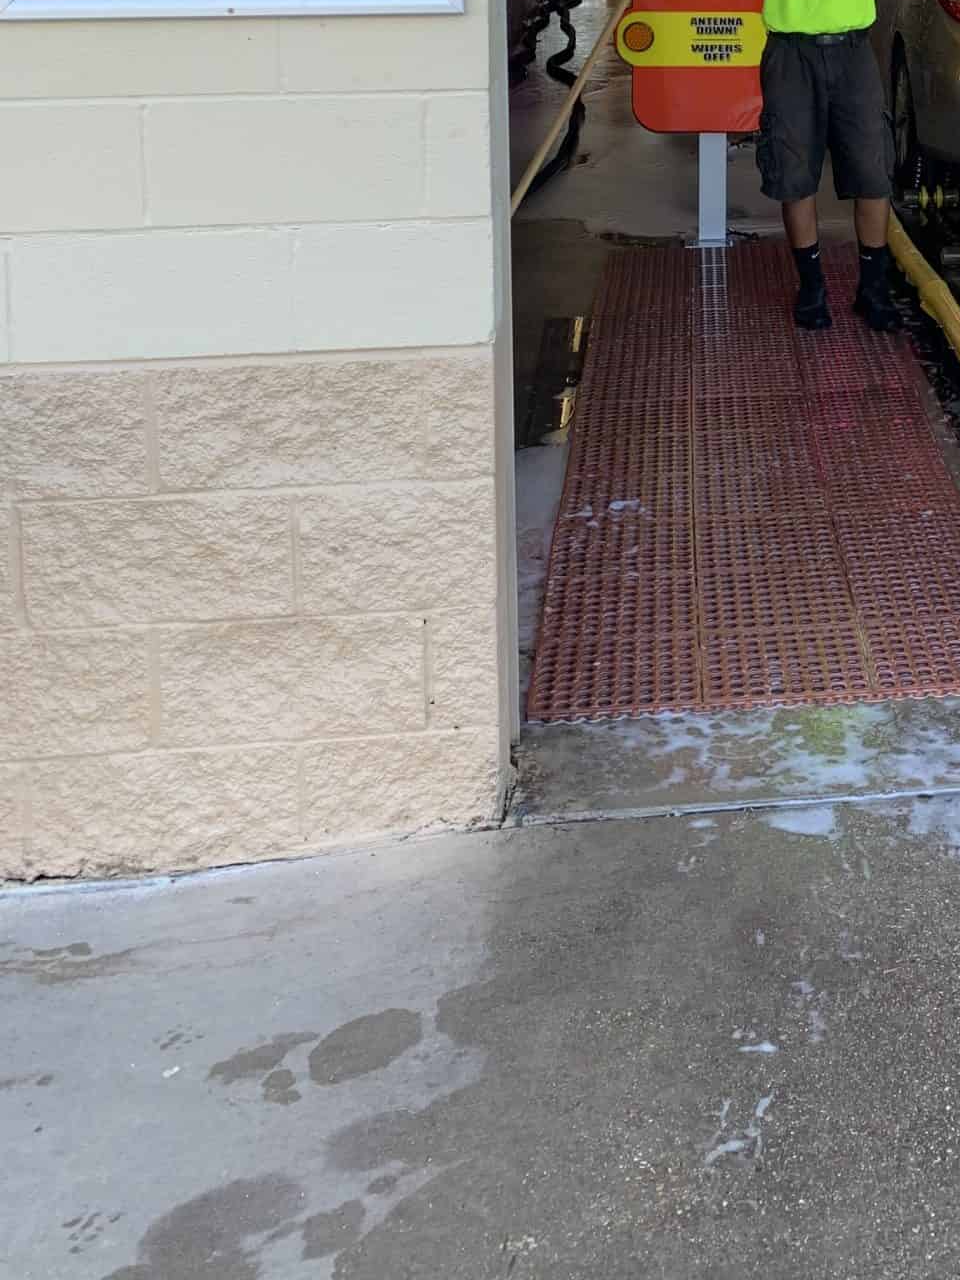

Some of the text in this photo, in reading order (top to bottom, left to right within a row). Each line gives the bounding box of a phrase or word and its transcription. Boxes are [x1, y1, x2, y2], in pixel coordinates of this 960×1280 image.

[690, 17, 743, 26] ANTENNA
[696, 26, 738, 35] DOWN!
[691, 44, 743, 53] WIPERS
[703, 52, 731, 62] OFF!
